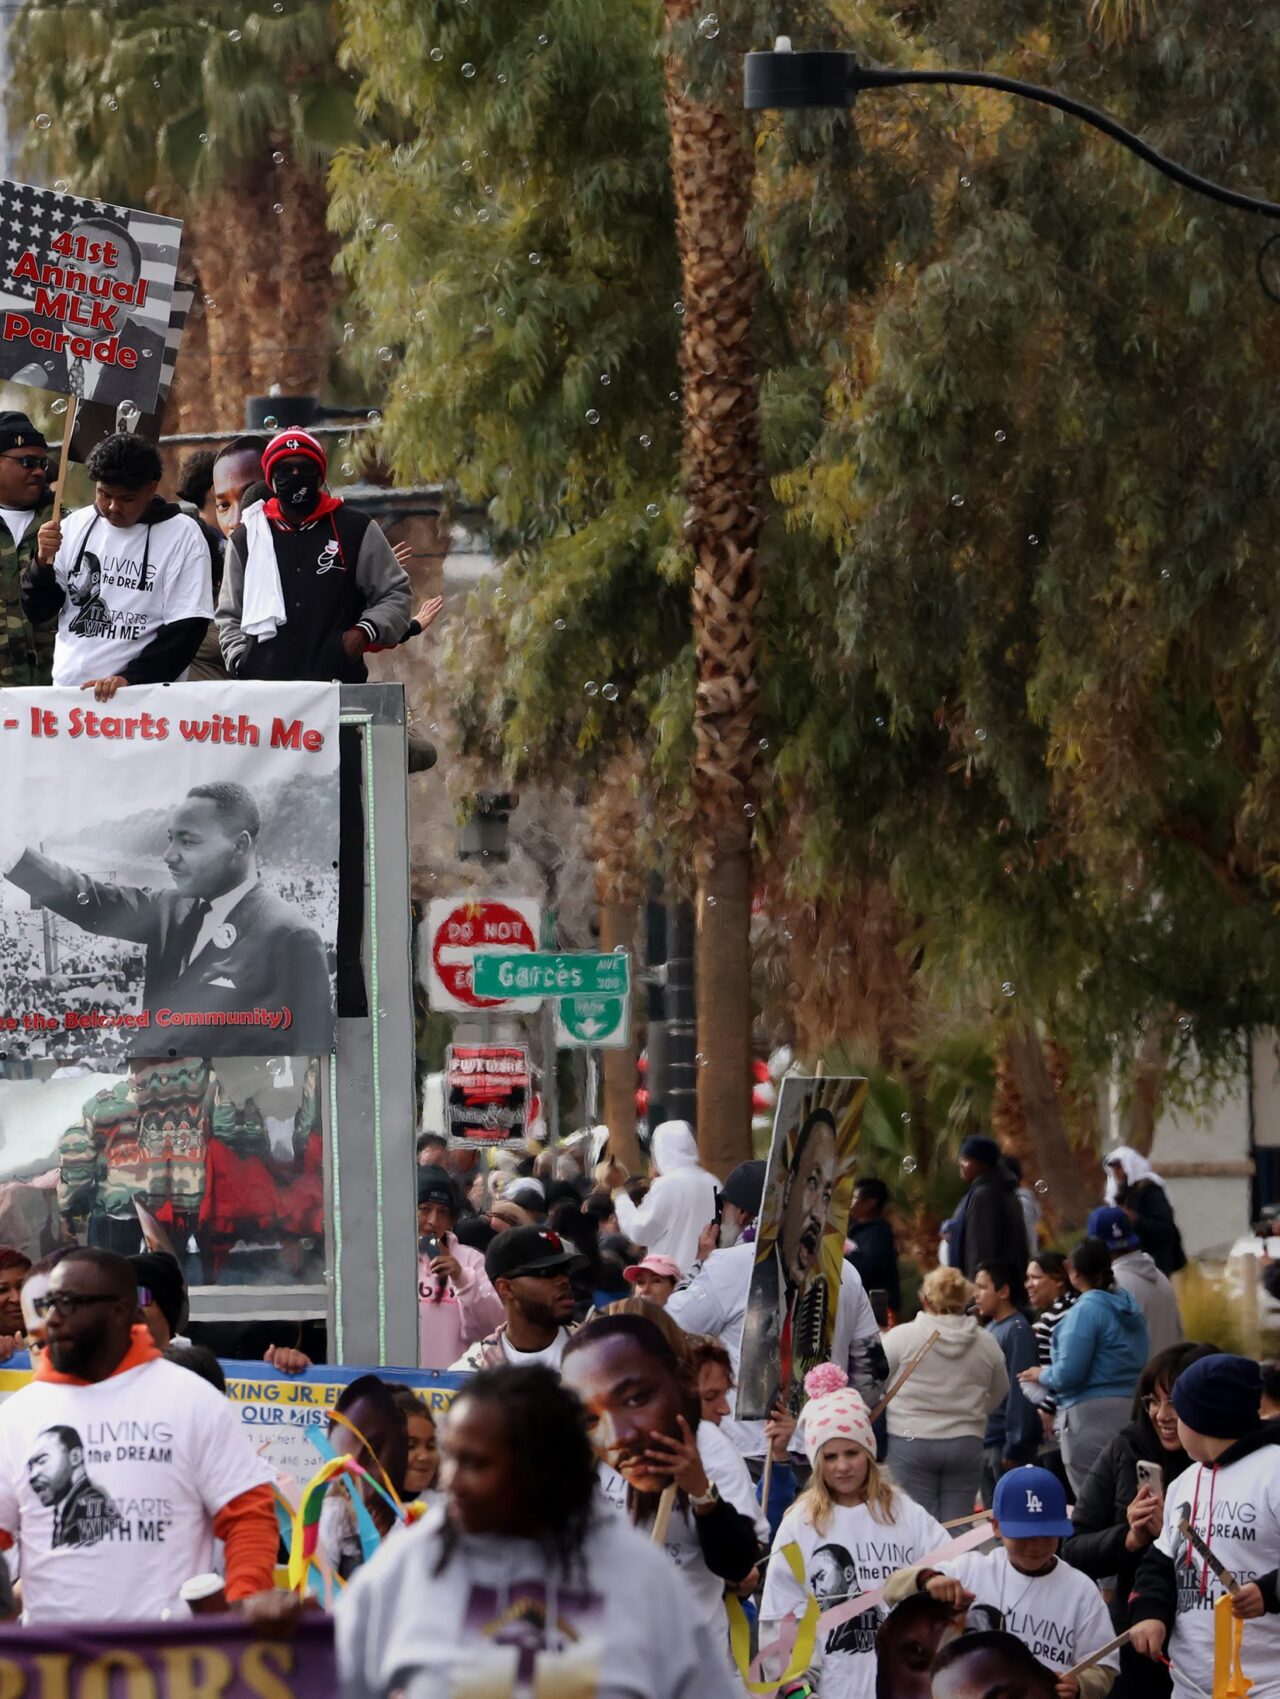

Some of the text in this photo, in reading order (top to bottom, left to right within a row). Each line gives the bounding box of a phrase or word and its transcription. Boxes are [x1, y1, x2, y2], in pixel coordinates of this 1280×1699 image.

[51, 231, 119, 267] 41st
[11, 251, 149, 307] Annual
[34, 287, 119, 333] MLK
[3, 312, 138, 369] Parade
[102, 555, 157, 580] LIVING
[102, 609, 148, 625] STARTS
[30, 706, 59, 738] It
[68, 706, 169, 741] Starts
[179, 713, 259, 747] with
[270, 716, 324, 752] Me
[448, 922, 523, 941] DO NOT
[23, 1012, 58, 1031] the
[65, 1010, 150, 1029] Beloved
[155, 1006, 292, 1030] Community)
[227, 1382, 280, 1401] KING
[287, 1386, 319, 1404] JR.
[241, 1405, 331, 1427] OUR MISS
[87, 1421, 174, 1445] LIVING
[116, 1447, 173, 1464] DREAM
[1026, 1489, 1043, 1513] LA
[1209, 1524, 1256, 1541] DREAM
[858, 1565, 880, 1580] the
